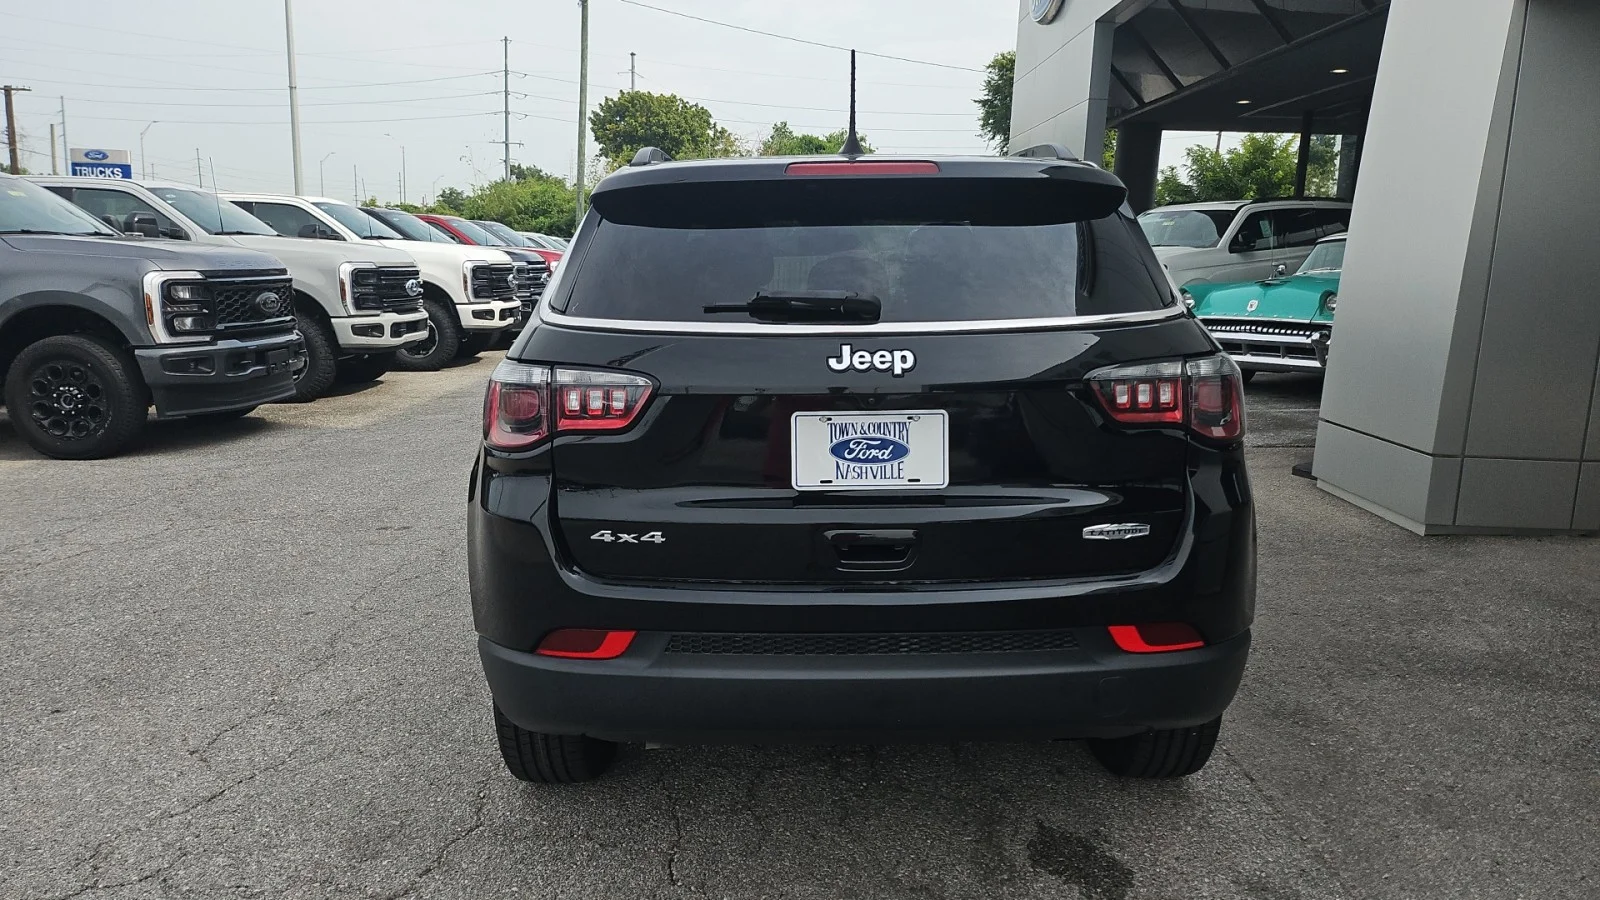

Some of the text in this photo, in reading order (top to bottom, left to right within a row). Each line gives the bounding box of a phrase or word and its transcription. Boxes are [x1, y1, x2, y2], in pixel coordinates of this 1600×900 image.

[74, 166, 123, 179] TRUCKS
[827, 344, 916, 377] Jeep
[827, 422, 858, 443] TOWN
[844, 439, 894, 460] Ford
[835, 460, 904, 480] NASHVILLE
[590, 530, 666, 544] 4x4
